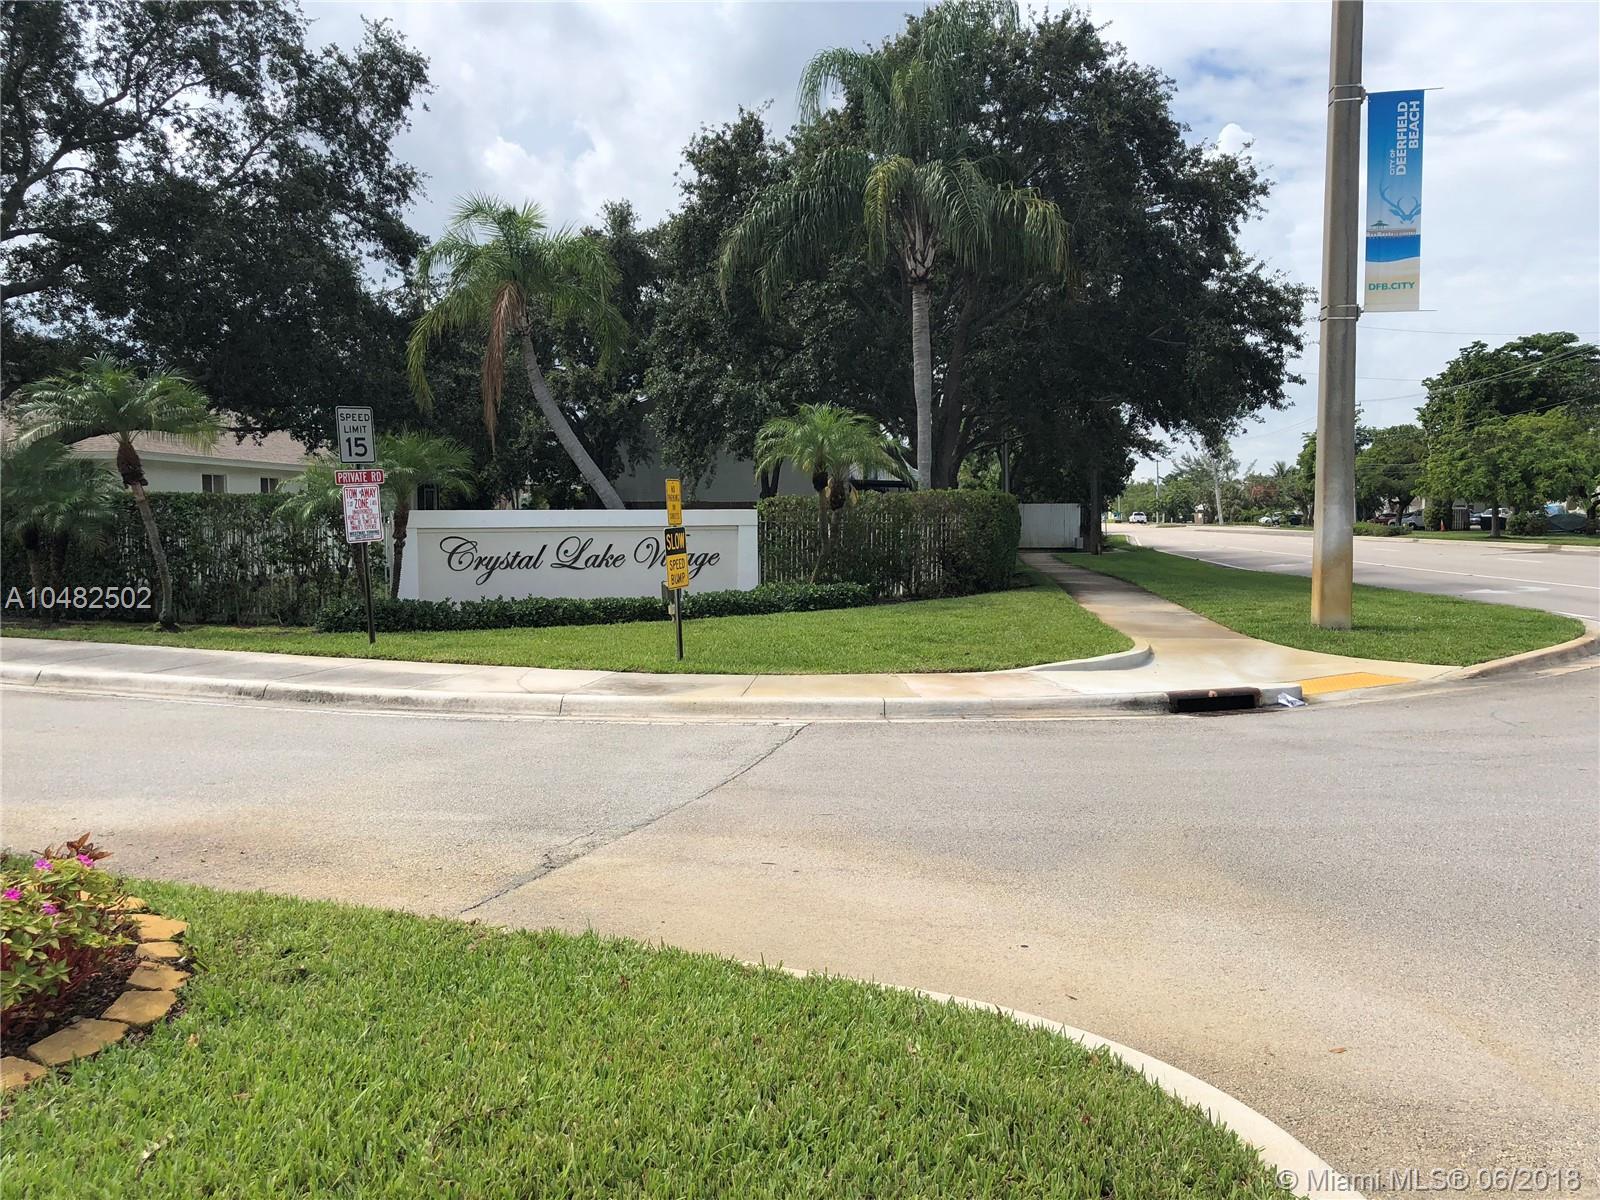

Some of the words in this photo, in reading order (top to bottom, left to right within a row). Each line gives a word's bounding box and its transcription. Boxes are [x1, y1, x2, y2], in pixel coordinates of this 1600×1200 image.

[1408, 100, 1420, 149] BEACH
[1396, 101, 1408, 176] DEERFIELD
[1368, 281, 1415, 291] DFB.CITY
[340, 412, 370, 421] SPEED
[343, 425, 367, 433] LIMIT
[345, 436, 368, 457] 15
[337, 471, 368, 483] PRIVATE
[370, 470, 382, 482] RD
[346, 488, 357, 499] TOW
[360, 487, 377, 498] AWAY
[354, 498, 369, 509] ZONE
[666, 532, 685, 550] SLOW
[440, 536, 548, 585] Crystal
[550, 536, 626, 570] Lake
[669, 557, 686, 571] SPEED
[670, 572, 686, 586] BUMP
